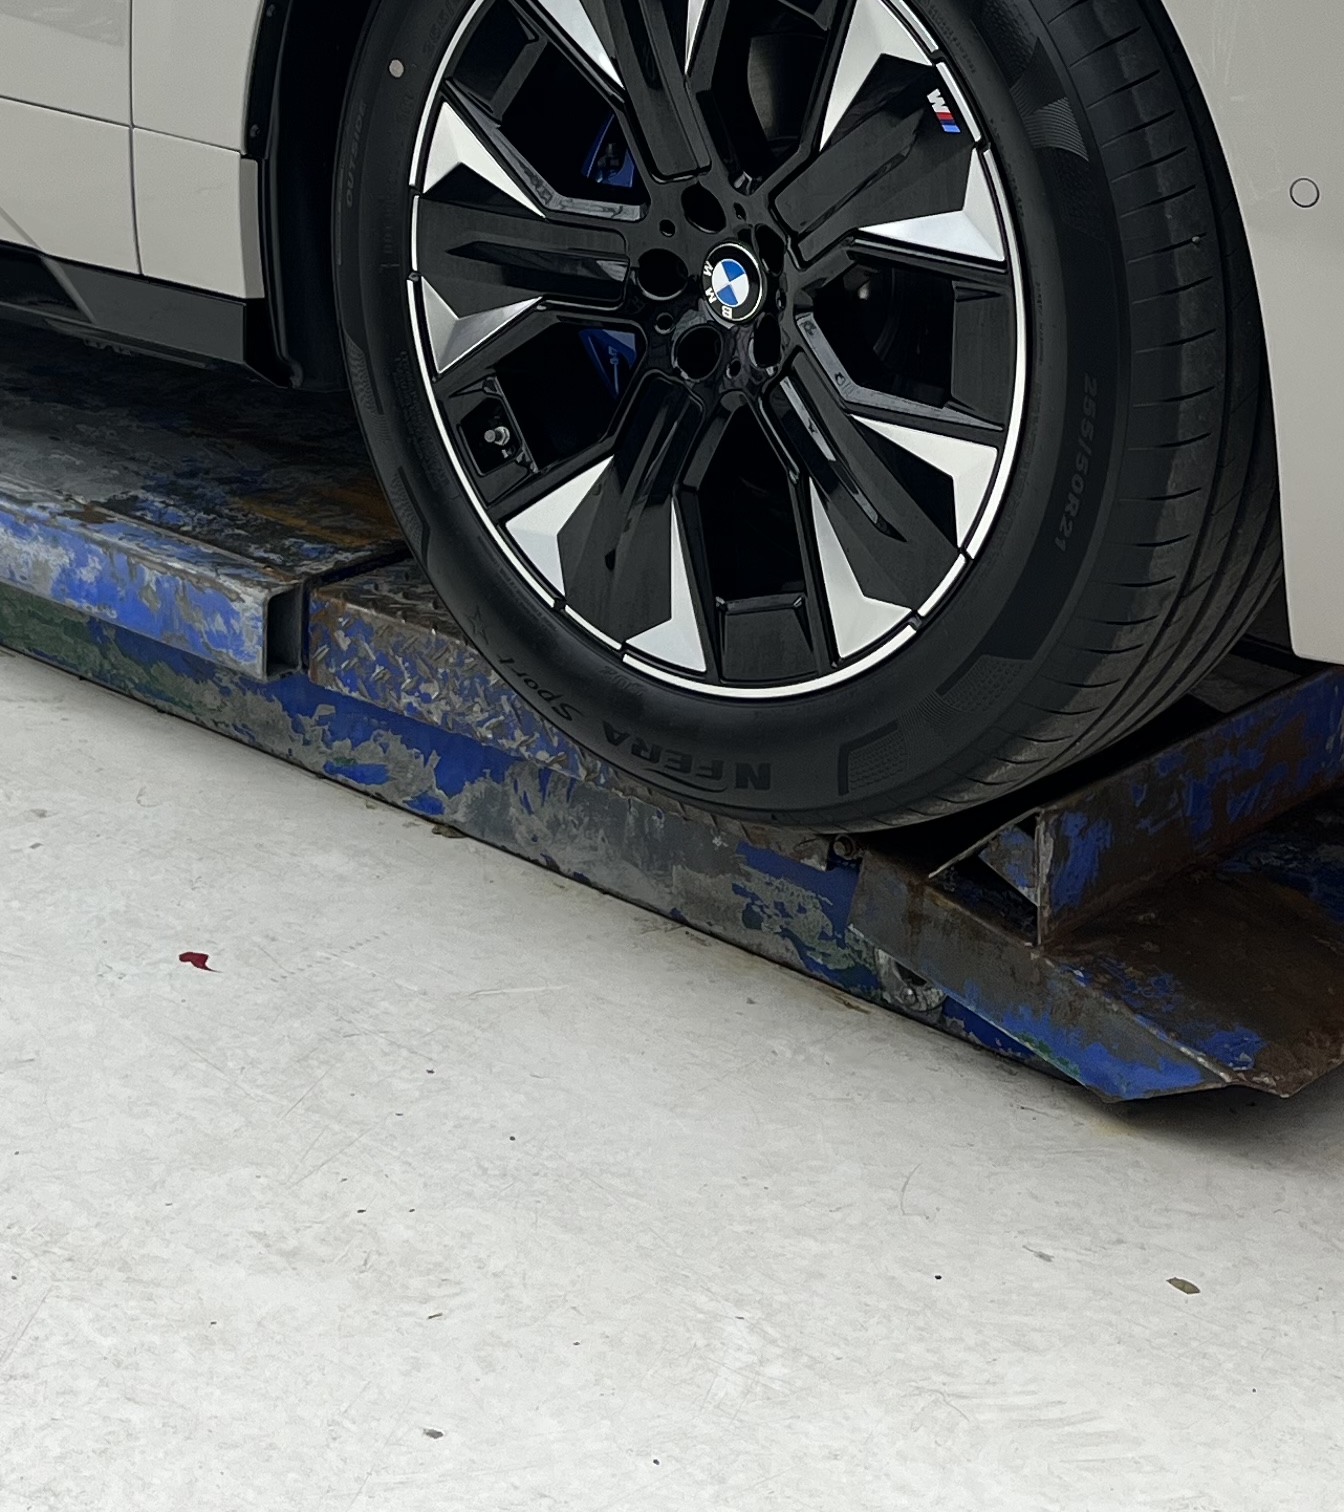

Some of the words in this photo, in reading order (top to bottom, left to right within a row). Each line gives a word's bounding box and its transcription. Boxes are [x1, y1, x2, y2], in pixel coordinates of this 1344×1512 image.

[346, 96, 368, 209] OUTSIDE
[702, 259, 734, 320] BMW
[1054, 371, 1099, 554] 255/50R21
[495, 652, 582, 724] Sport
[600, 720, 725, 782] FERA
